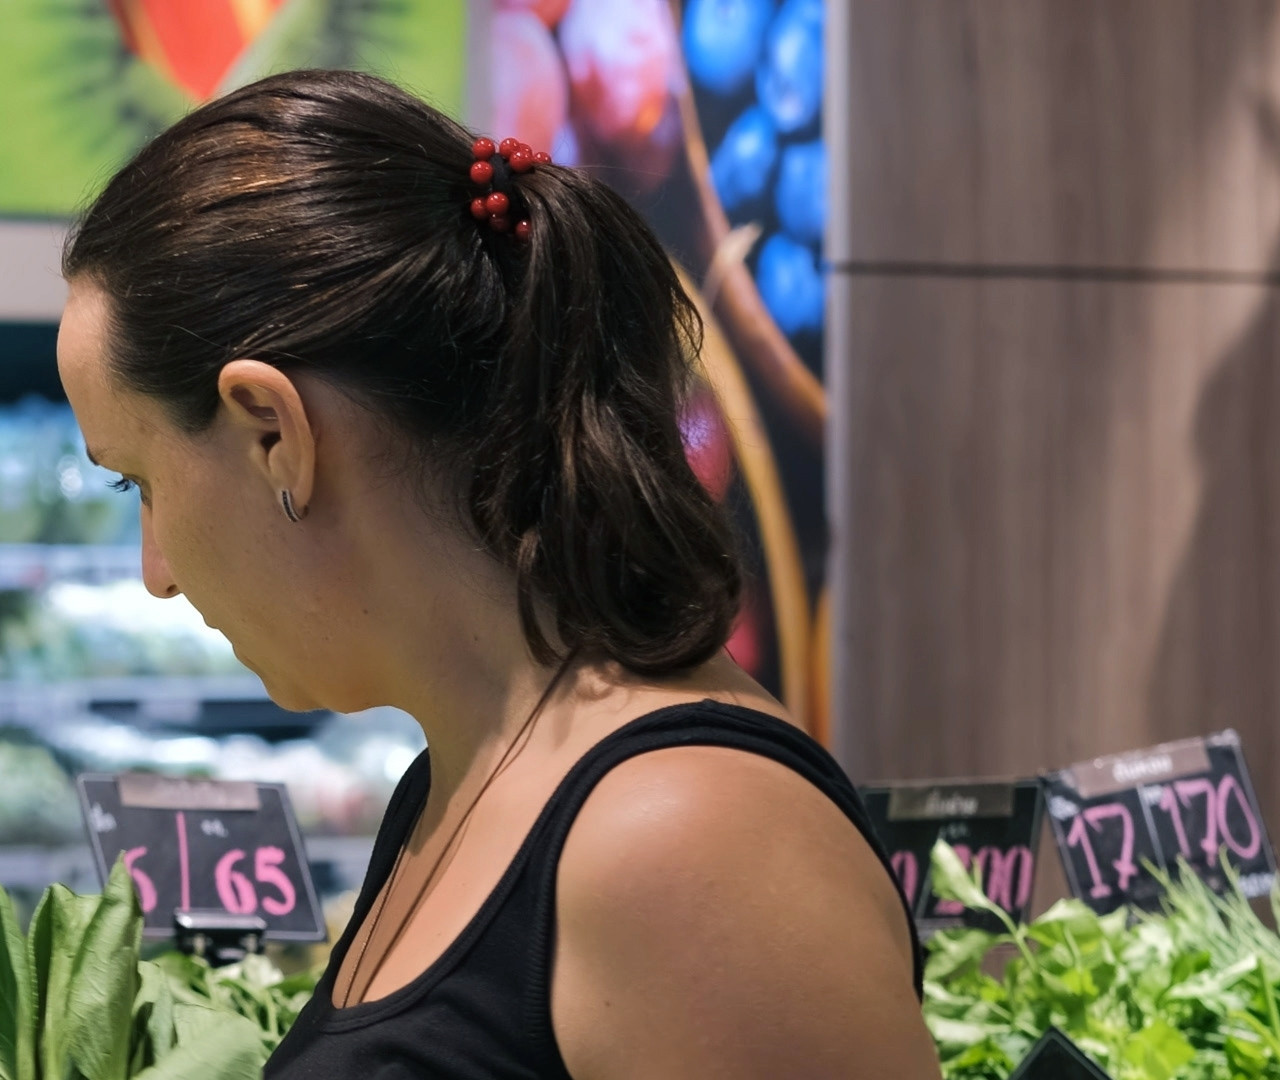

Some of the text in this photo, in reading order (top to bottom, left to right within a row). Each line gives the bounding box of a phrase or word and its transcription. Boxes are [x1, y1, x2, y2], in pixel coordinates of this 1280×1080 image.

[1067, 802, 1138, 899] 17
[1158, 773, 1261, 868] 170
[215, 845, 296, 916] 65
